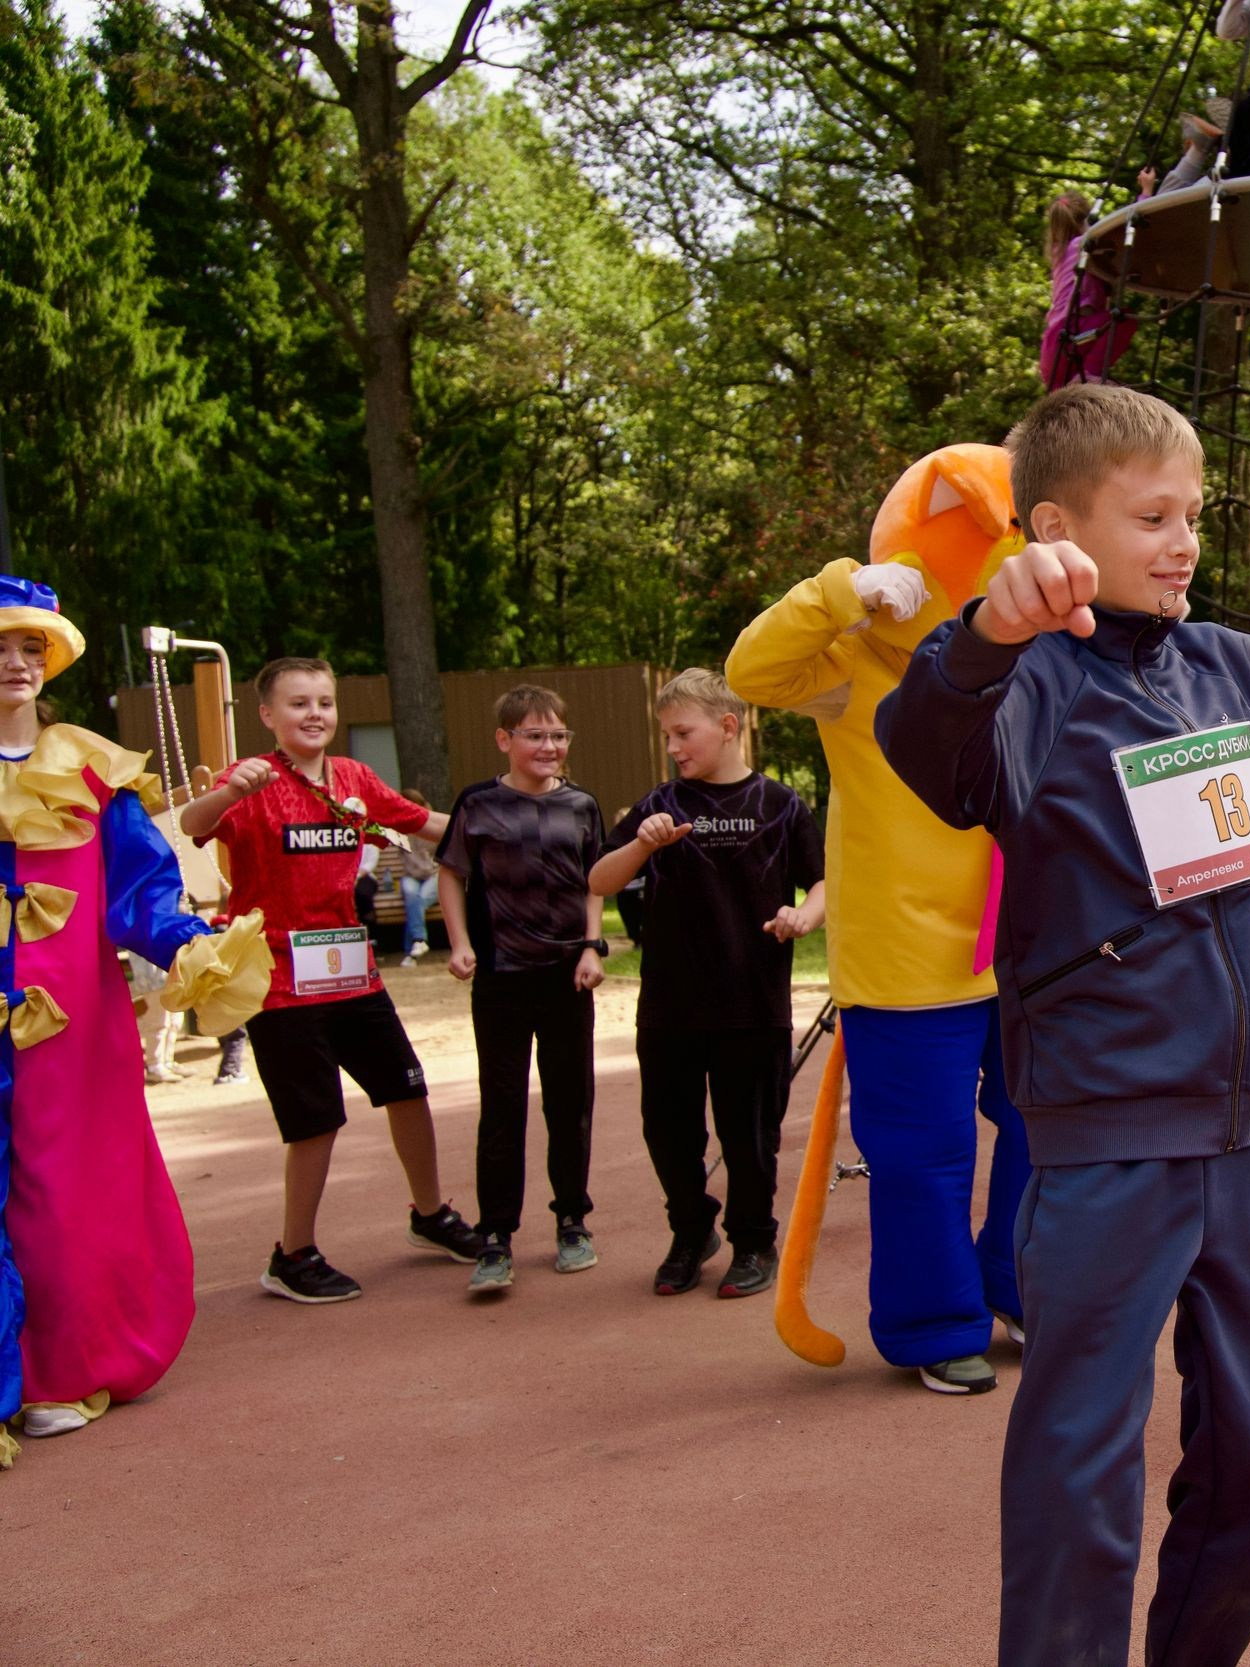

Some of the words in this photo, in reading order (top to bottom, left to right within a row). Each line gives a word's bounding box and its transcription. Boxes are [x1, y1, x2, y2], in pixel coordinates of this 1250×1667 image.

[1142, 743, 1215, 775] КРОСС
[1217, 736, 1250, 760] ДУБКИ
[692, 816, 755, 834] Storm
[289, 829, 332, 848] NIKE
[333, 828, 358, 847] F.C.
[1177, 859, 1244, 888] Апрелевка
[300, 934, 333, 944] КРОСС
[327, 947, 342, 975] 9
